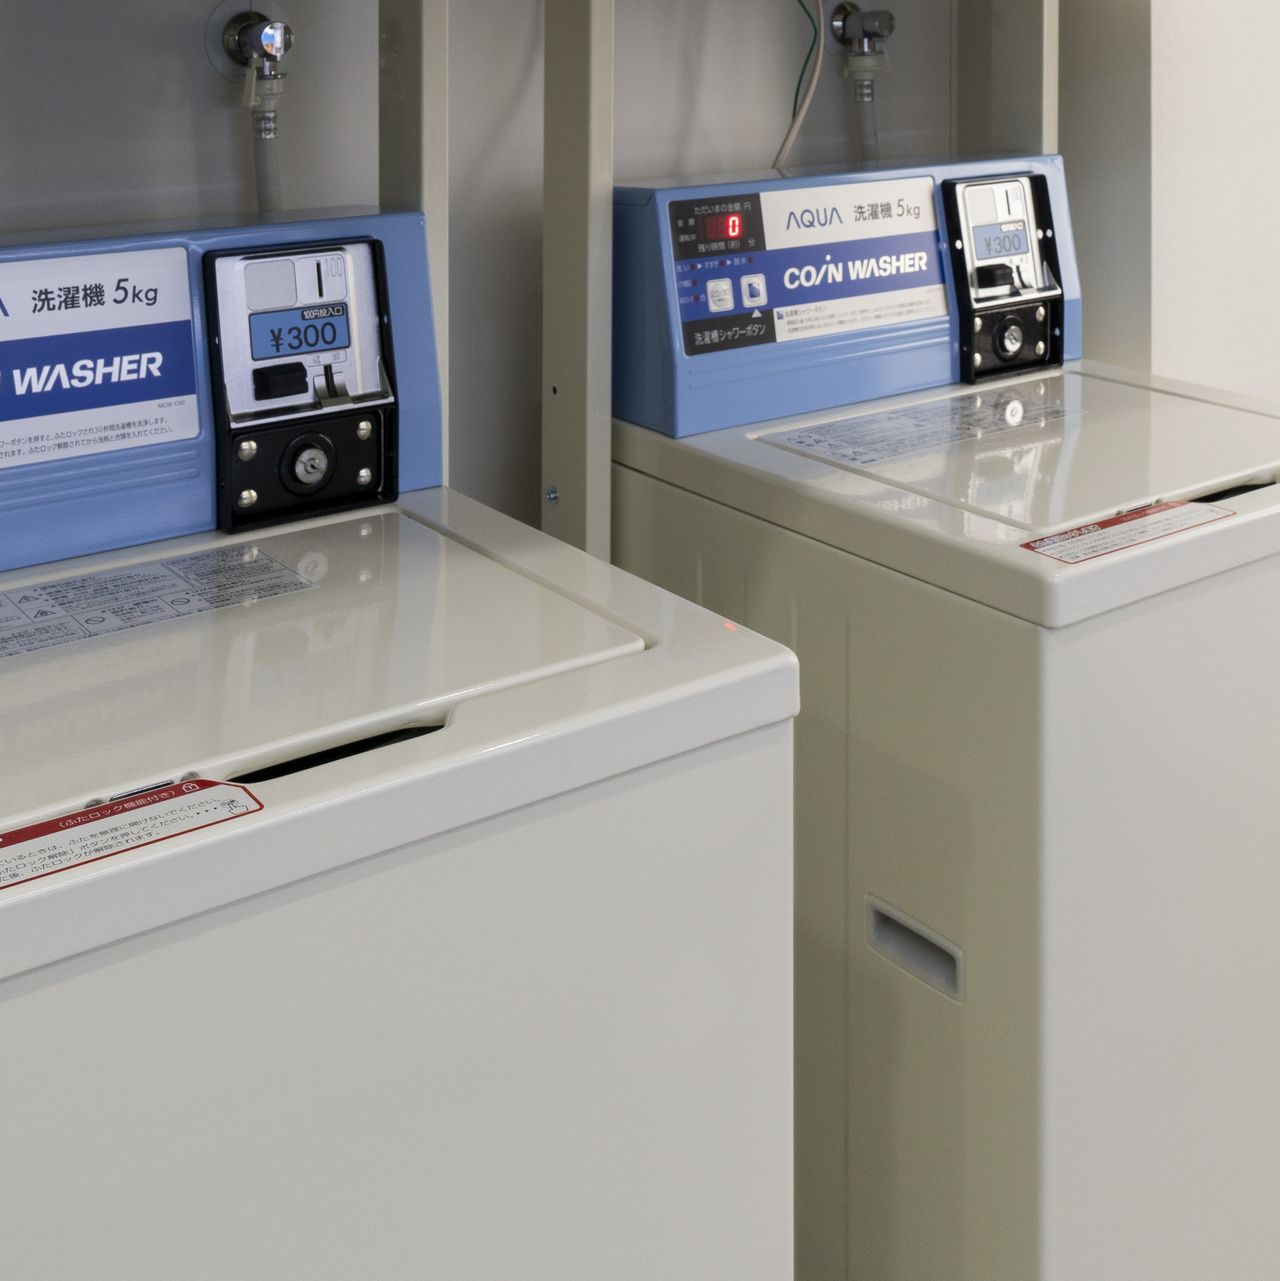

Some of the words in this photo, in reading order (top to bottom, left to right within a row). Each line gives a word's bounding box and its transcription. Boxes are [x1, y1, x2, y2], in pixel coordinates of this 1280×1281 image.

[728, 217, 739, 236] 0
[786, 207, 843, 230] AQUA
[853, 202, 893, 223] 洗濯機
[896, 199, 921, 219] 5kg
[984, 233, 1021, 255] ¥300
[848, 251, 928, 281] WASHER
[31, 282, 105, 314] 洗濯機
[113, 278, 158, 307] 5kg
[270, 322, 337, 353] ¥300
[13, 351, 163, 395] WASHER
